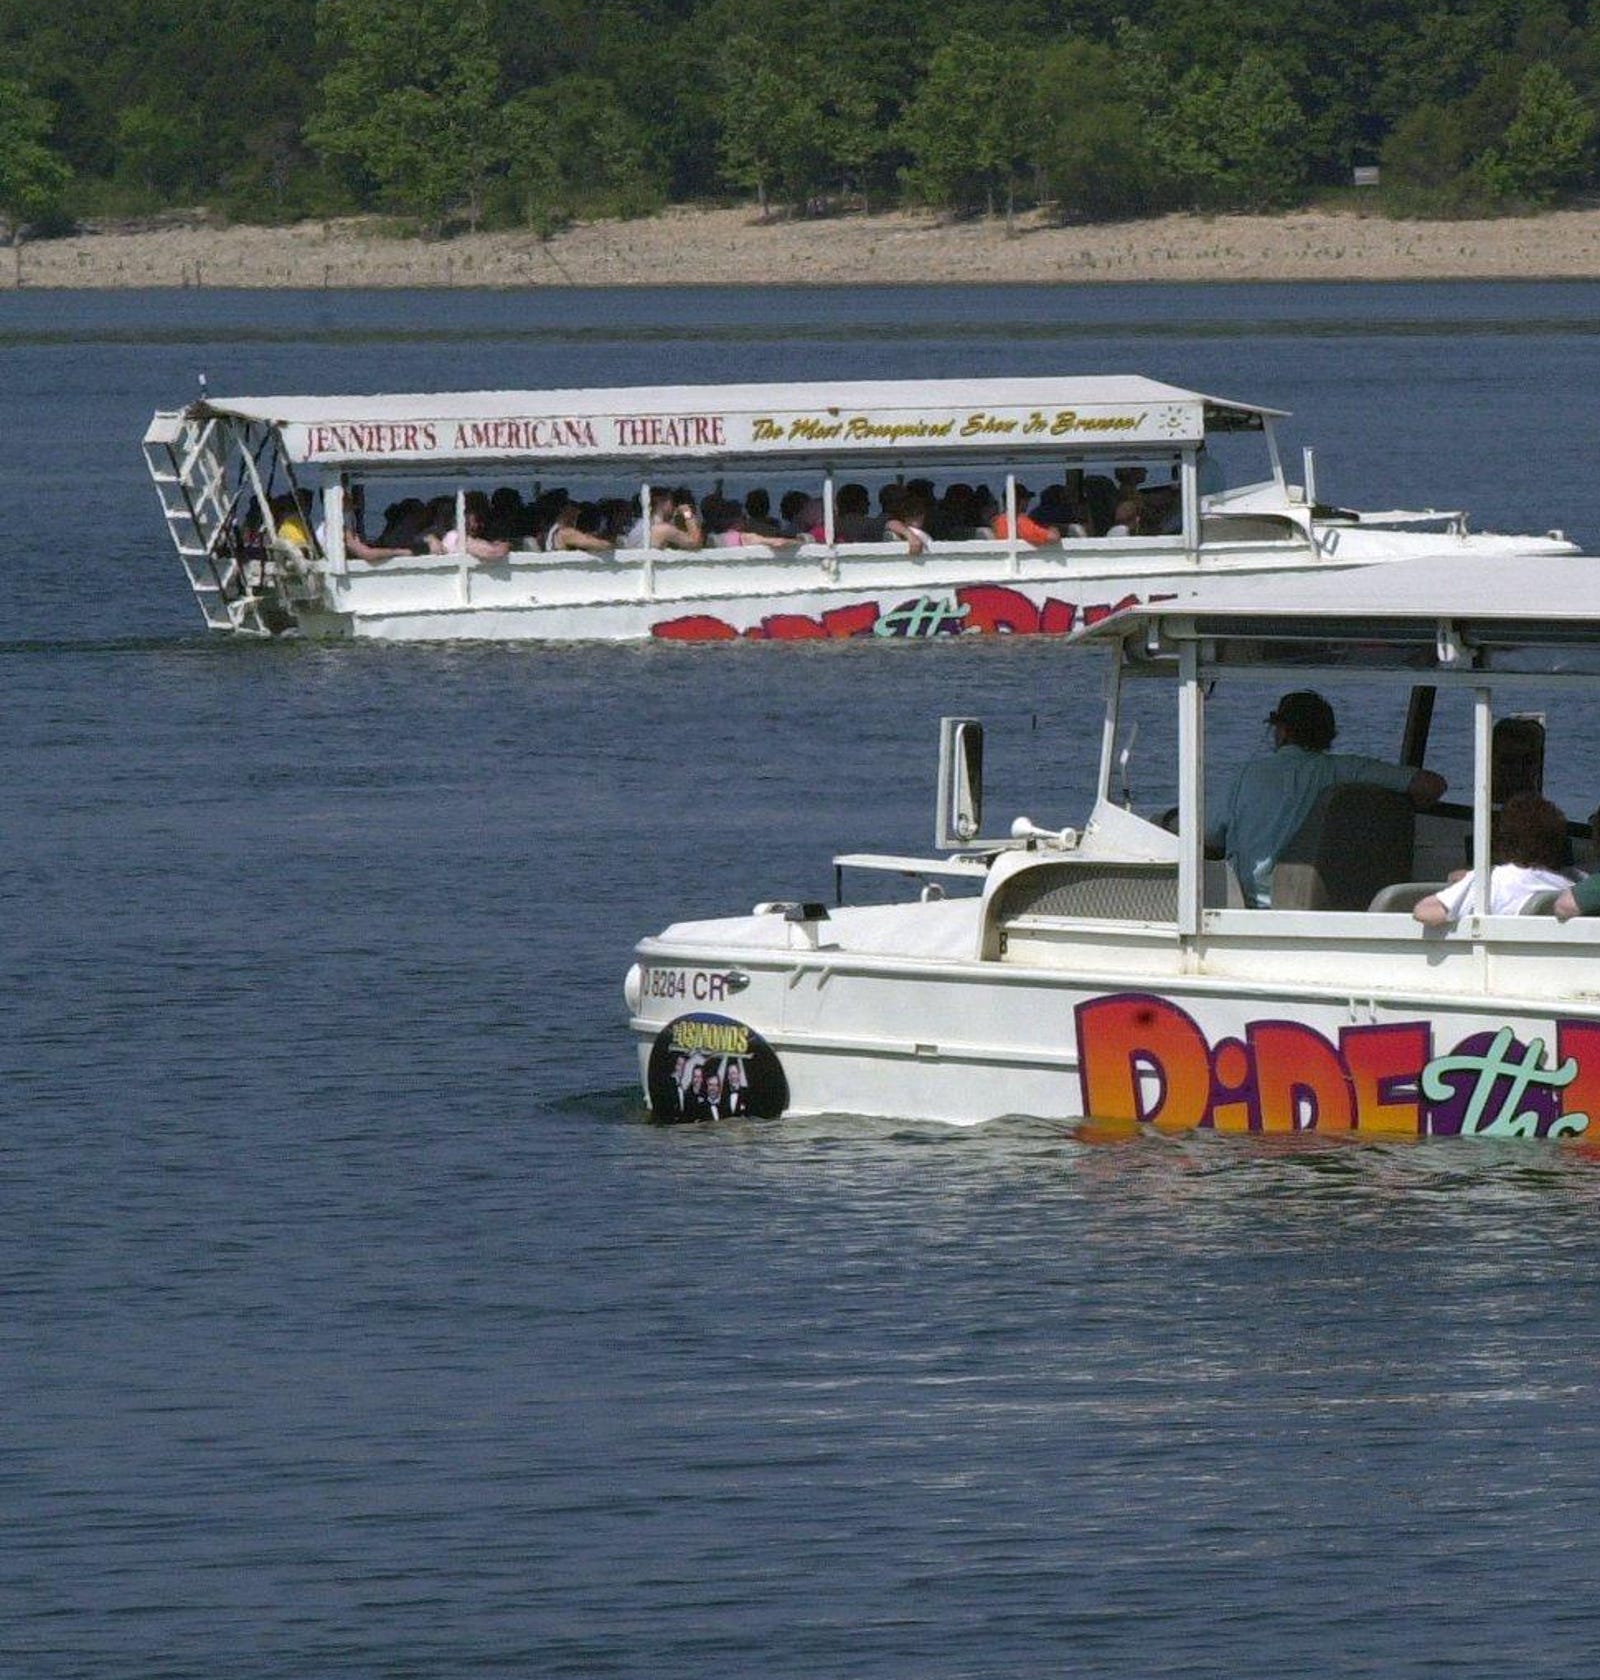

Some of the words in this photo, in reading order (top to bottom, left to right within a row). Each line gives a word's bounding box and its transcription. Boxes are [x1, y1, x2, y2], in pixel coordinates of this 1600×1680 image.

[303, 422, 437, 460] JENNIFER'S
[454, 417, 598, 449] AMERICANA
[614, 416, 727, 446] THEATRE
[752, 418, 785, 441] The
[788, 418, 844, 441] Most
[960, 412, 1018, 437] Show
[1023, 412, 1048, 434] In
[652, 969, 686, 998] 8284
[693, 972, 728, 1001] CR
